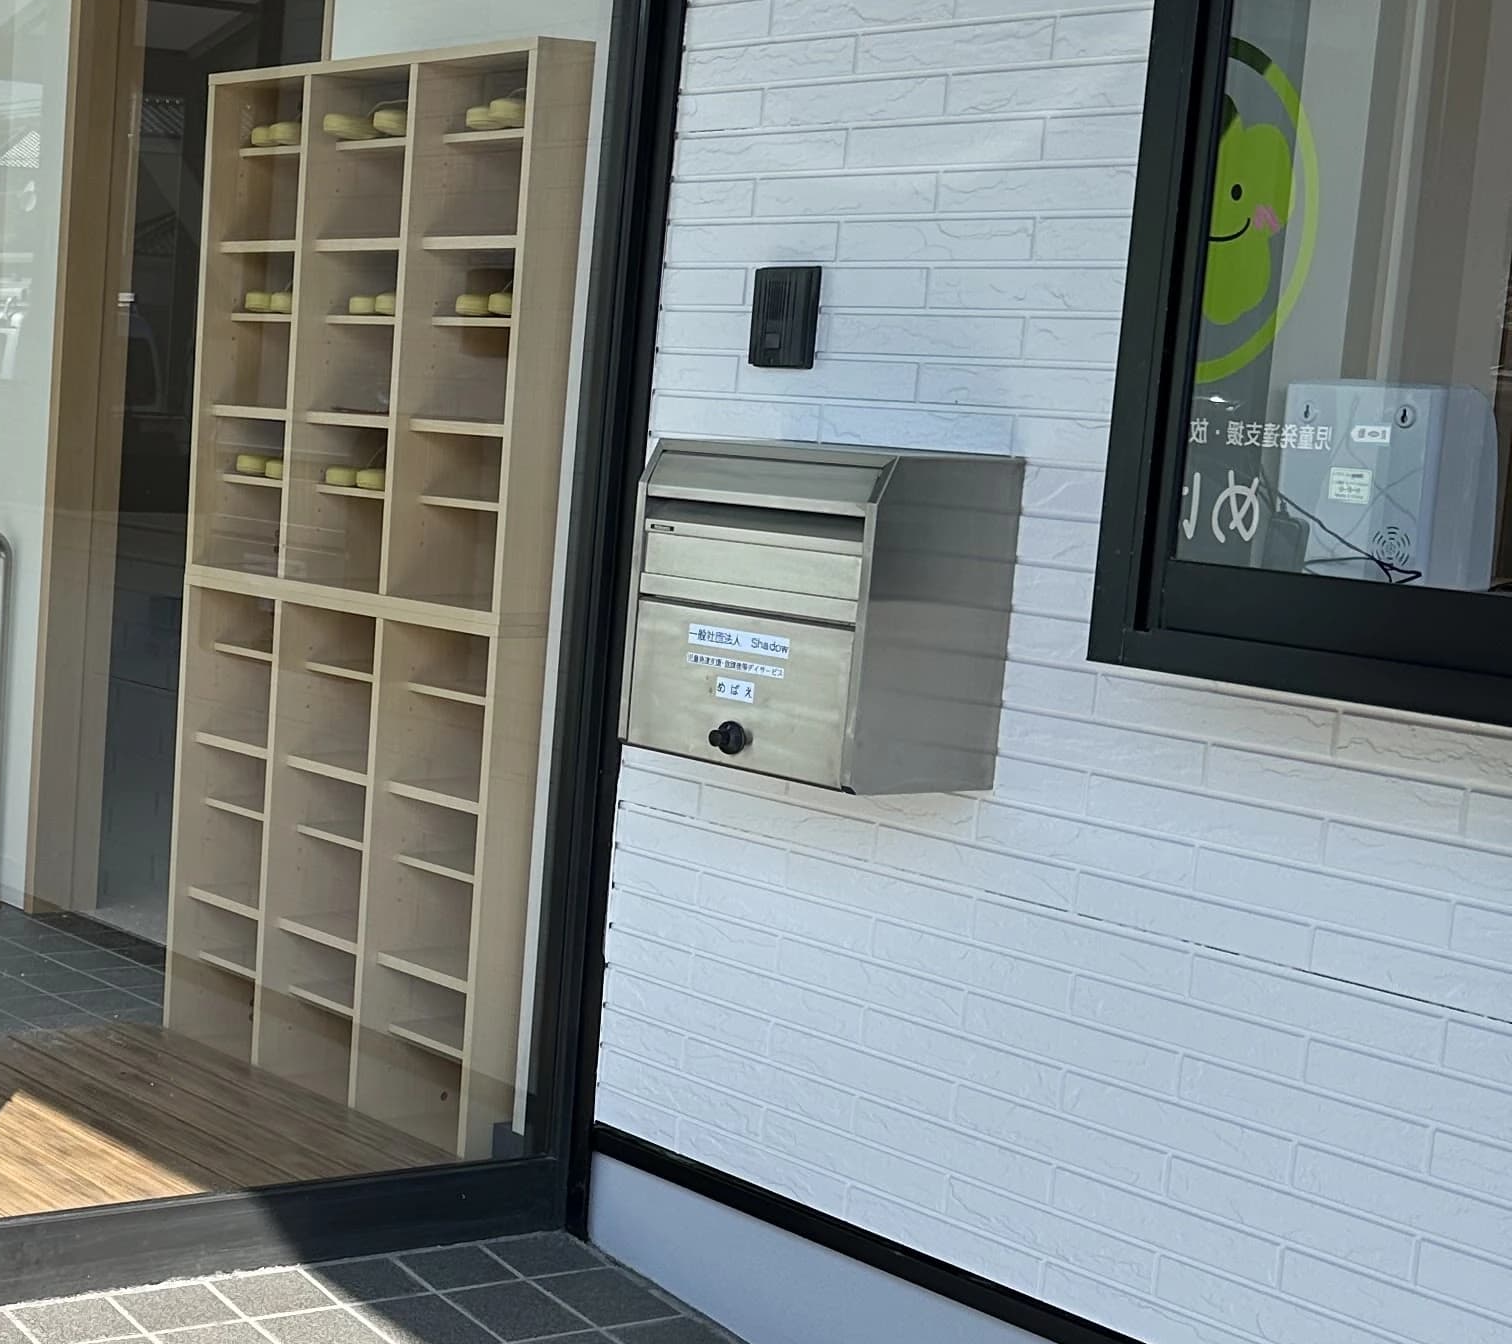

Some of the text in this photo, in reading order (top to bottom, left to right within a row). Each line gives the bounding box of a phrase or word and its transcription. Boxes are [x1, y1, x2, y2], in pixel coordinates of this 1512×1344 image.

[689, 628, 789, 655] 一般社団法人 Shadow
[717, 681, 753, 699] めばえ
